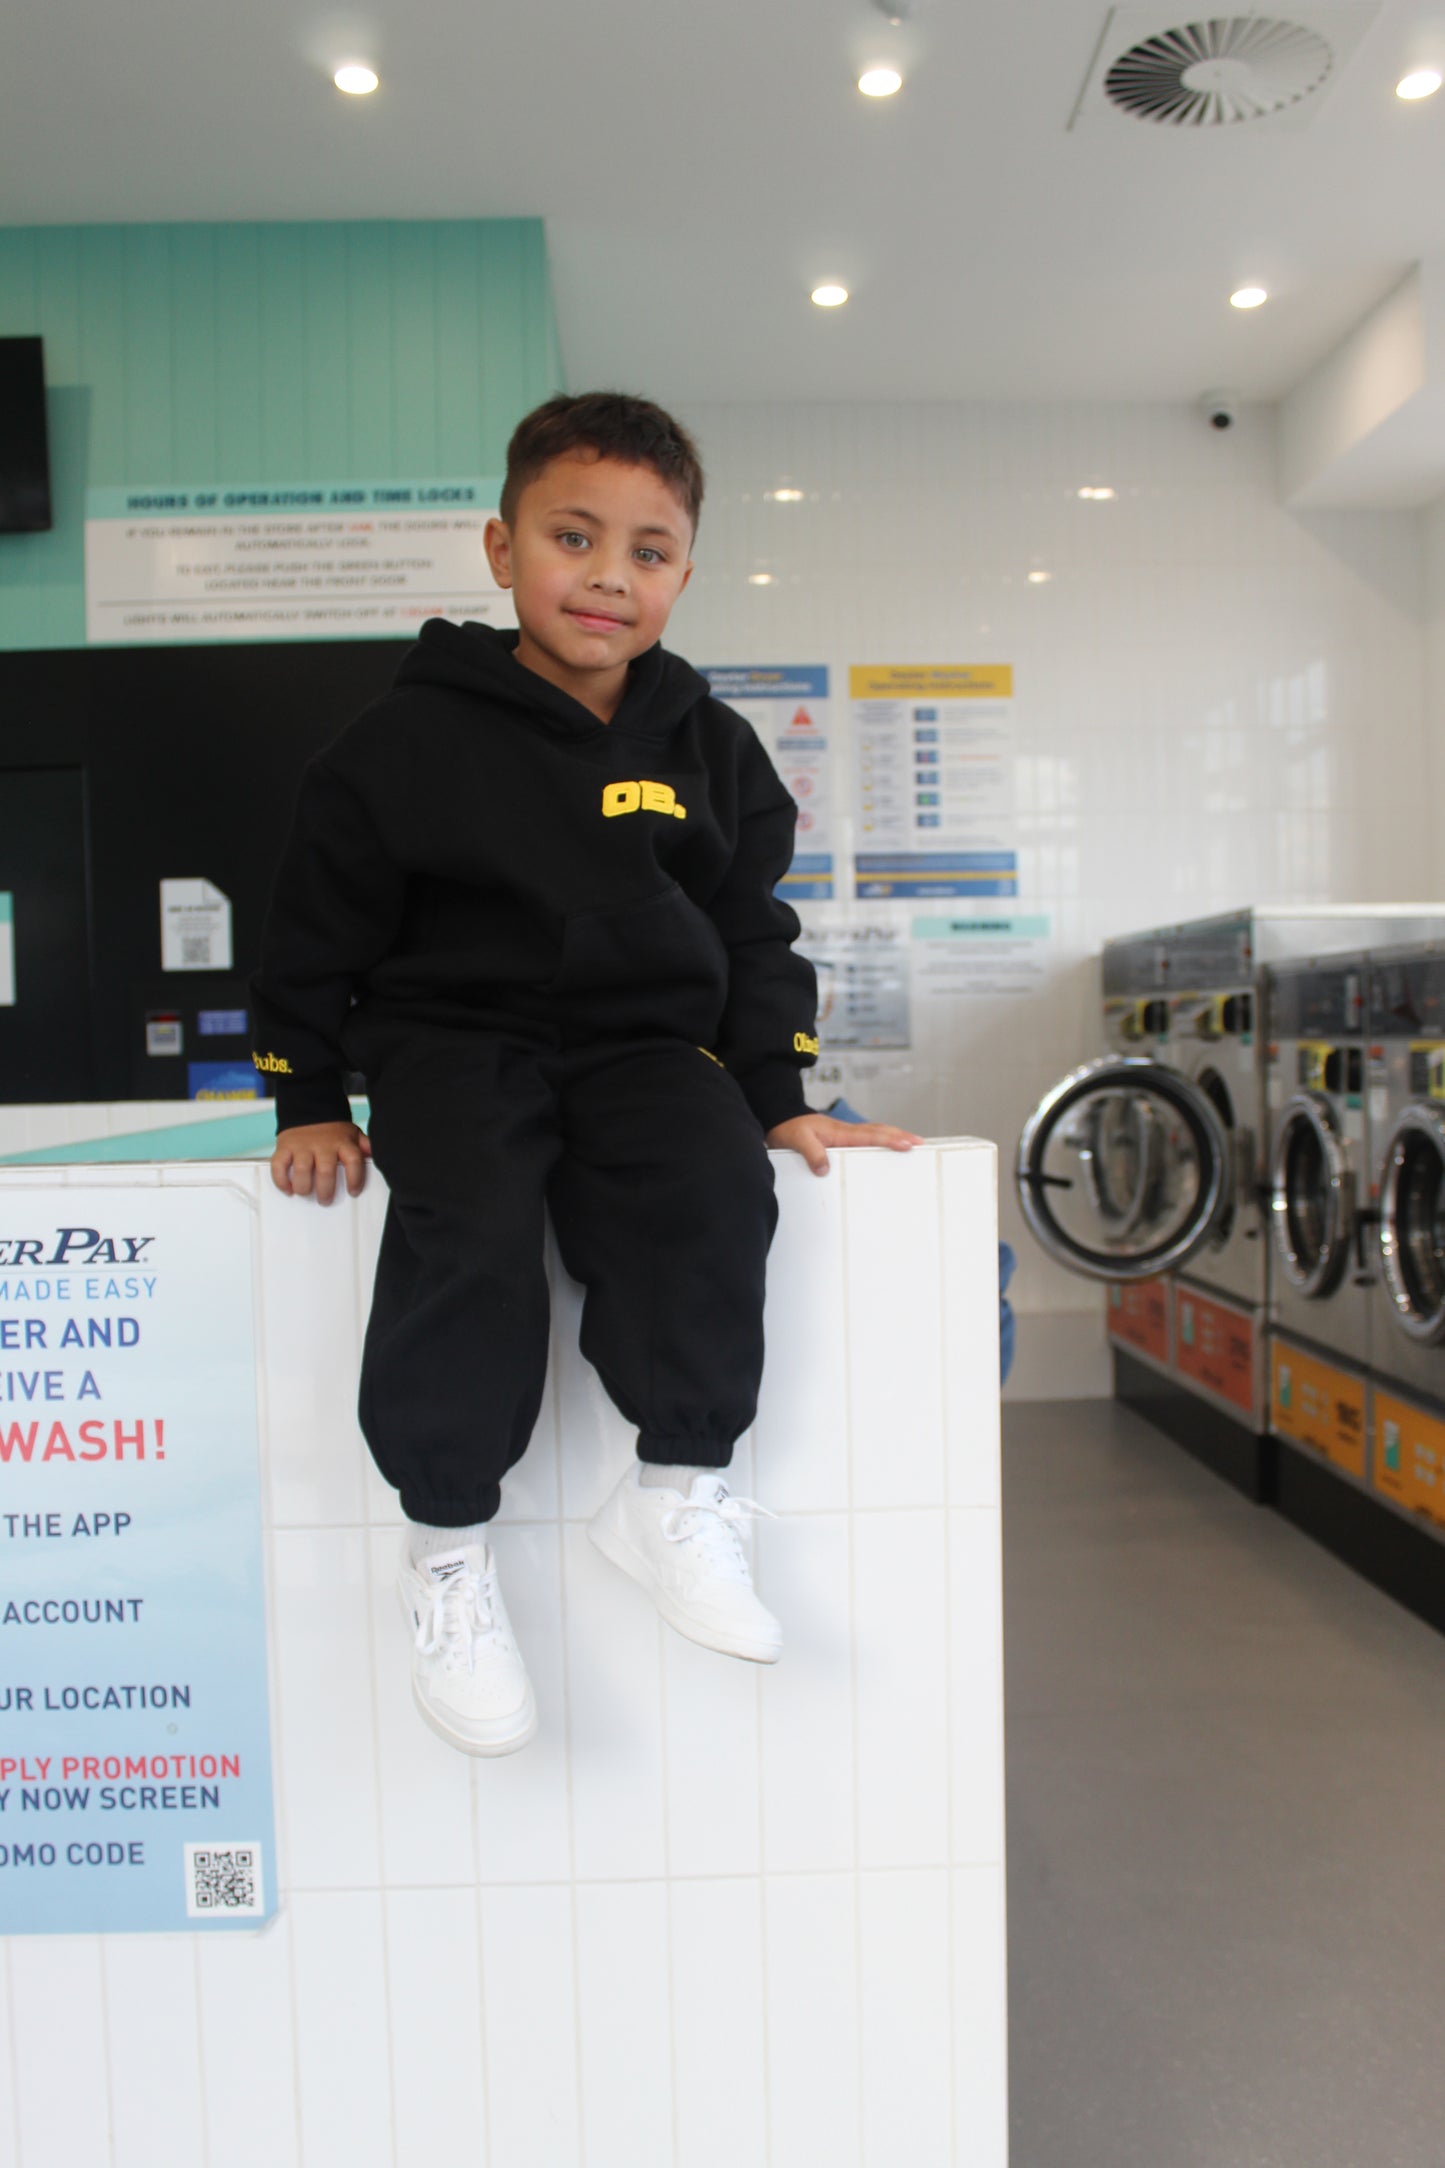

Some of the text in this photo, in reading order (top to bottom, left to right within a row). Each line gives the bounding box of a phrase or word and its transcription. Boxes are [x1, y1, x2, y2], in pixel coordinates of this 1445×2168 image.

[127, 487, 475, 510] HOURS OF OPERATION AND TIME LOCKS
[602, 780, 686, 818] OB.
[86, 1277, 157, 1300] EASY
[0, 1317, 140, 1349] ER AND
[0, 1371, 102, 1401] IVE A
[0, 1419, 165, 1462] WASH!
[3, 1512, 132, 1538] THE APP
[2, 1599, 144, 1625] ACCOUNT
[45, 1684, 191, 1710] LOCATION
[0, 1754, 241, 1781] PLY PROMOTION
[21, 1788, 90, 1812] NOW
[100, 1785, 220, 1810] SCREEN
[67, 1841, 145, 1866] CODE
